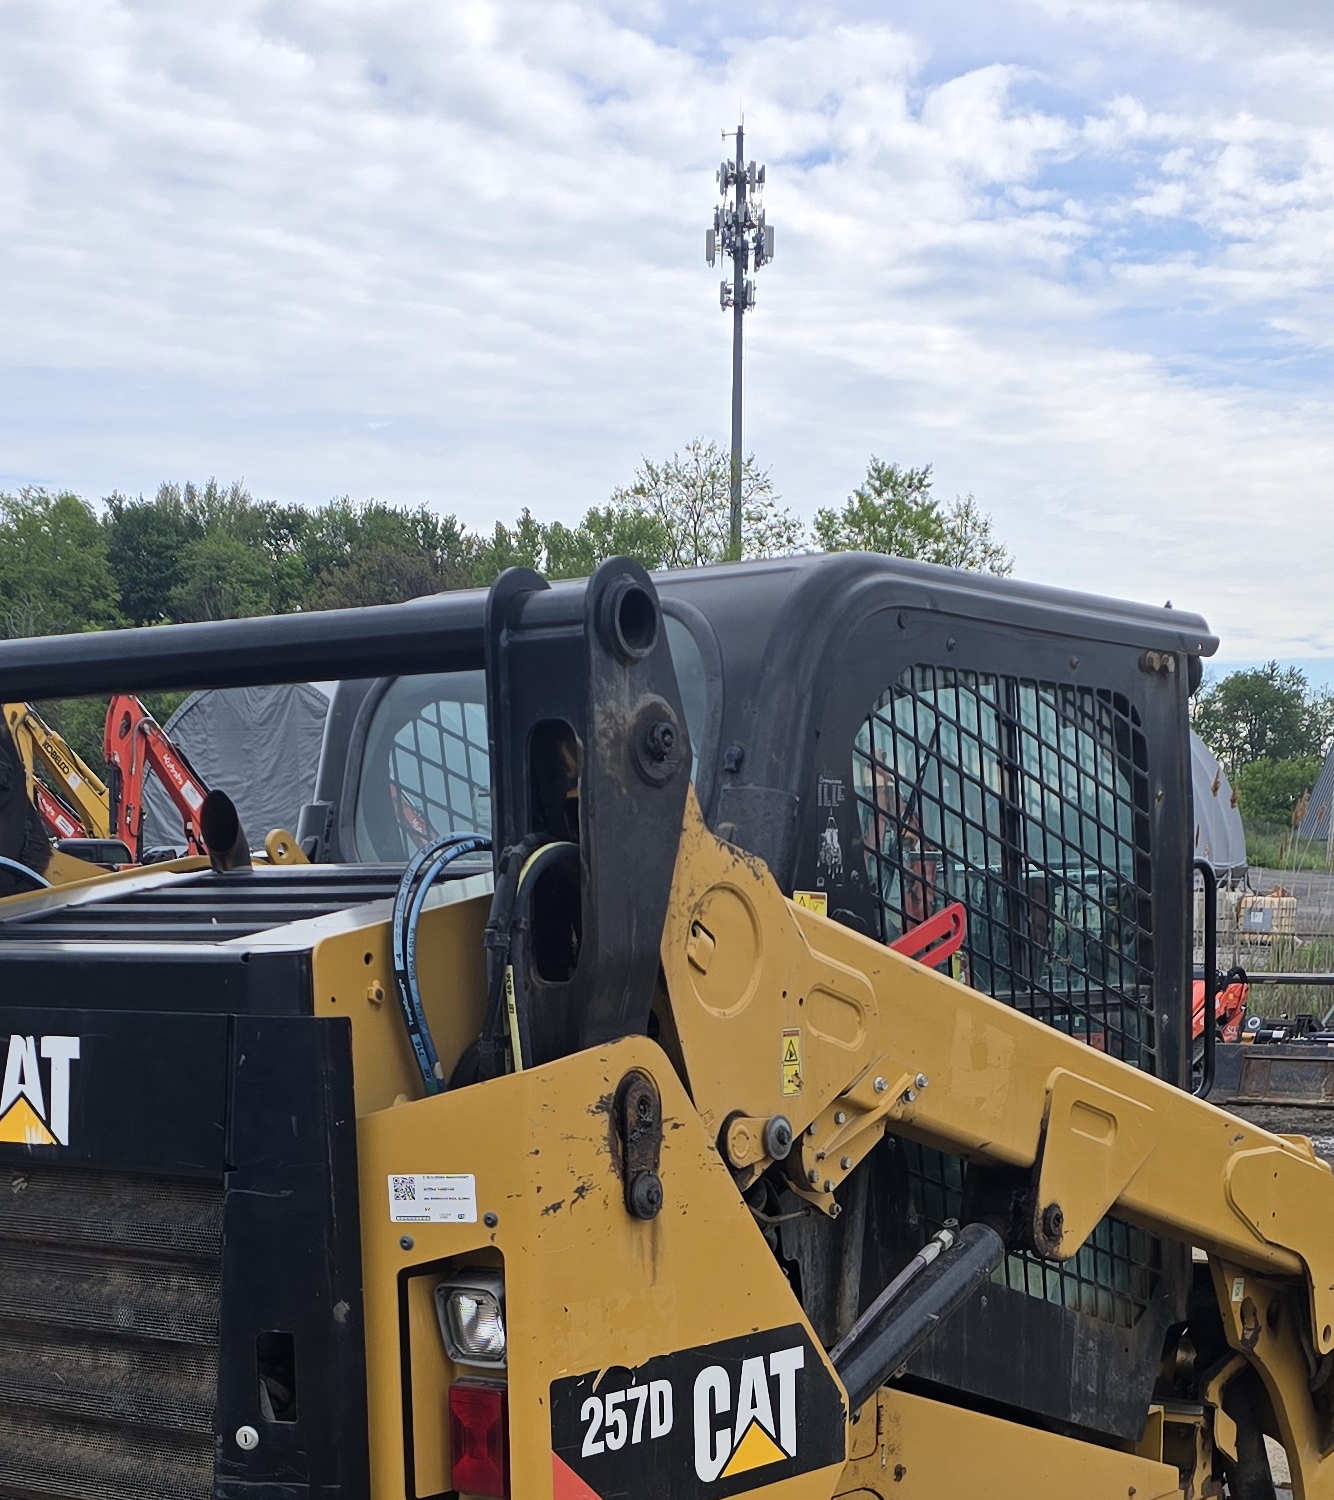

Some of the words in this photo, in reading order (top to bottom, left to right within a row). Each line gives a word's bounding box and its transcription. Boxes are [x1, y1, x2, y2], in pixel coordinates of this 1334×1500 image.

[42, 740, 69, 775] KOBELCO
[580, 1379, 674, 1458] 257D
[693, 1345, 805, 1483] CAT
